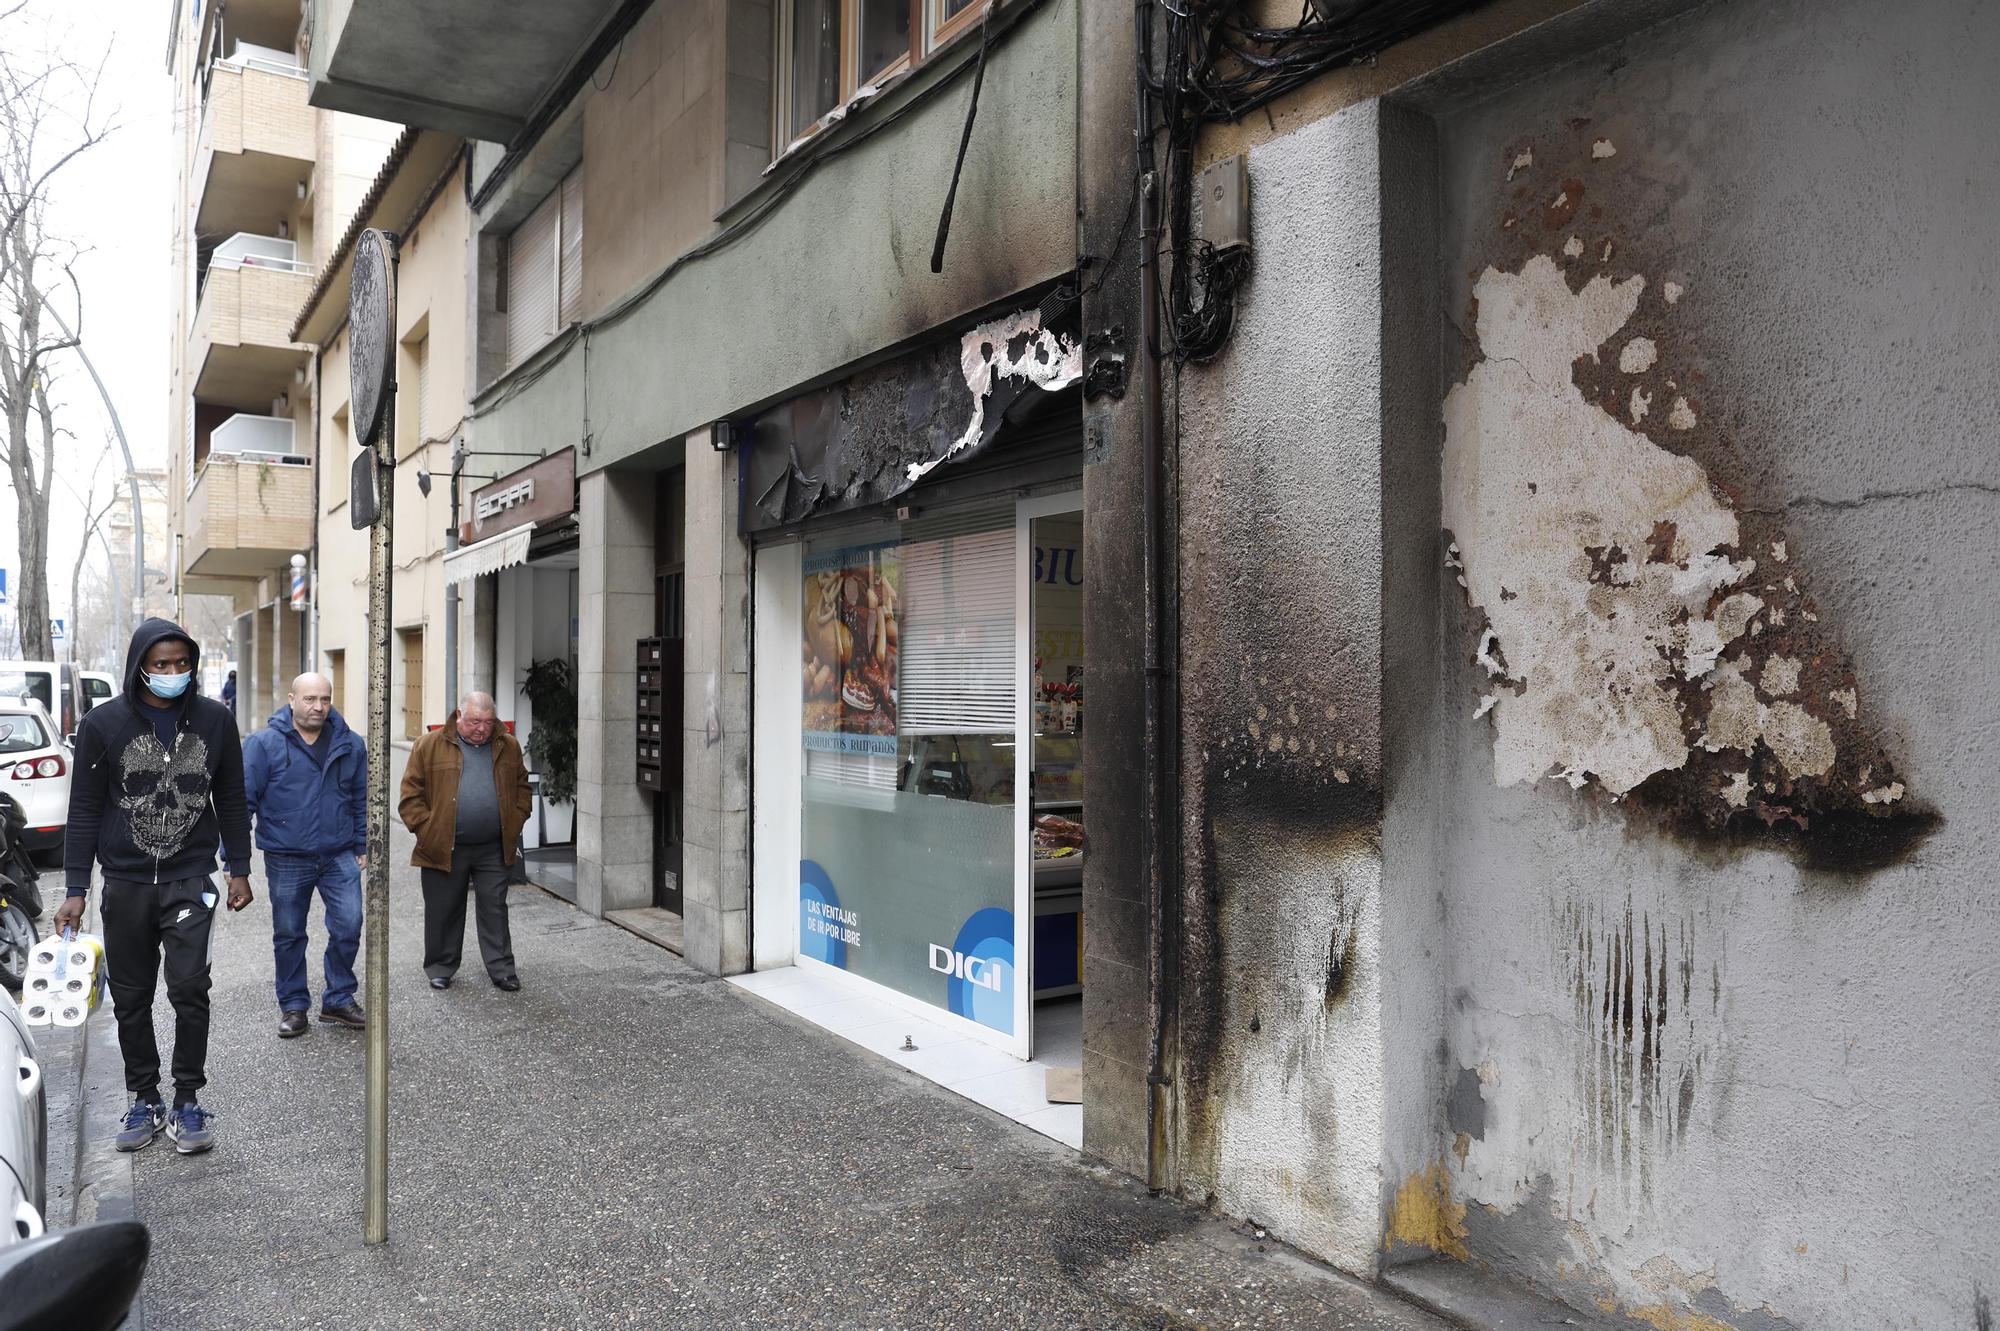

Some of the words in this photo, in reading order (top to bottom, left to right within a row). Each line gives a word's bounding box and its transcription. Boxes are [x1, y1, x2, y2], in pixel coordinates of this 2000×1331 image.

[802, 735, 847, 750] PRODUCTOS
[808, 899, 820, 915] LAS
[821, 903, 857, 927] VENTAJAS
[808, 917, 816, 932] DE
[818, 920, 825, 935] IR
[825, 922, 840, 940] POR
[841, 927, 861, 947] LIBRE
[929, 943, 1001, 992] DIGI
